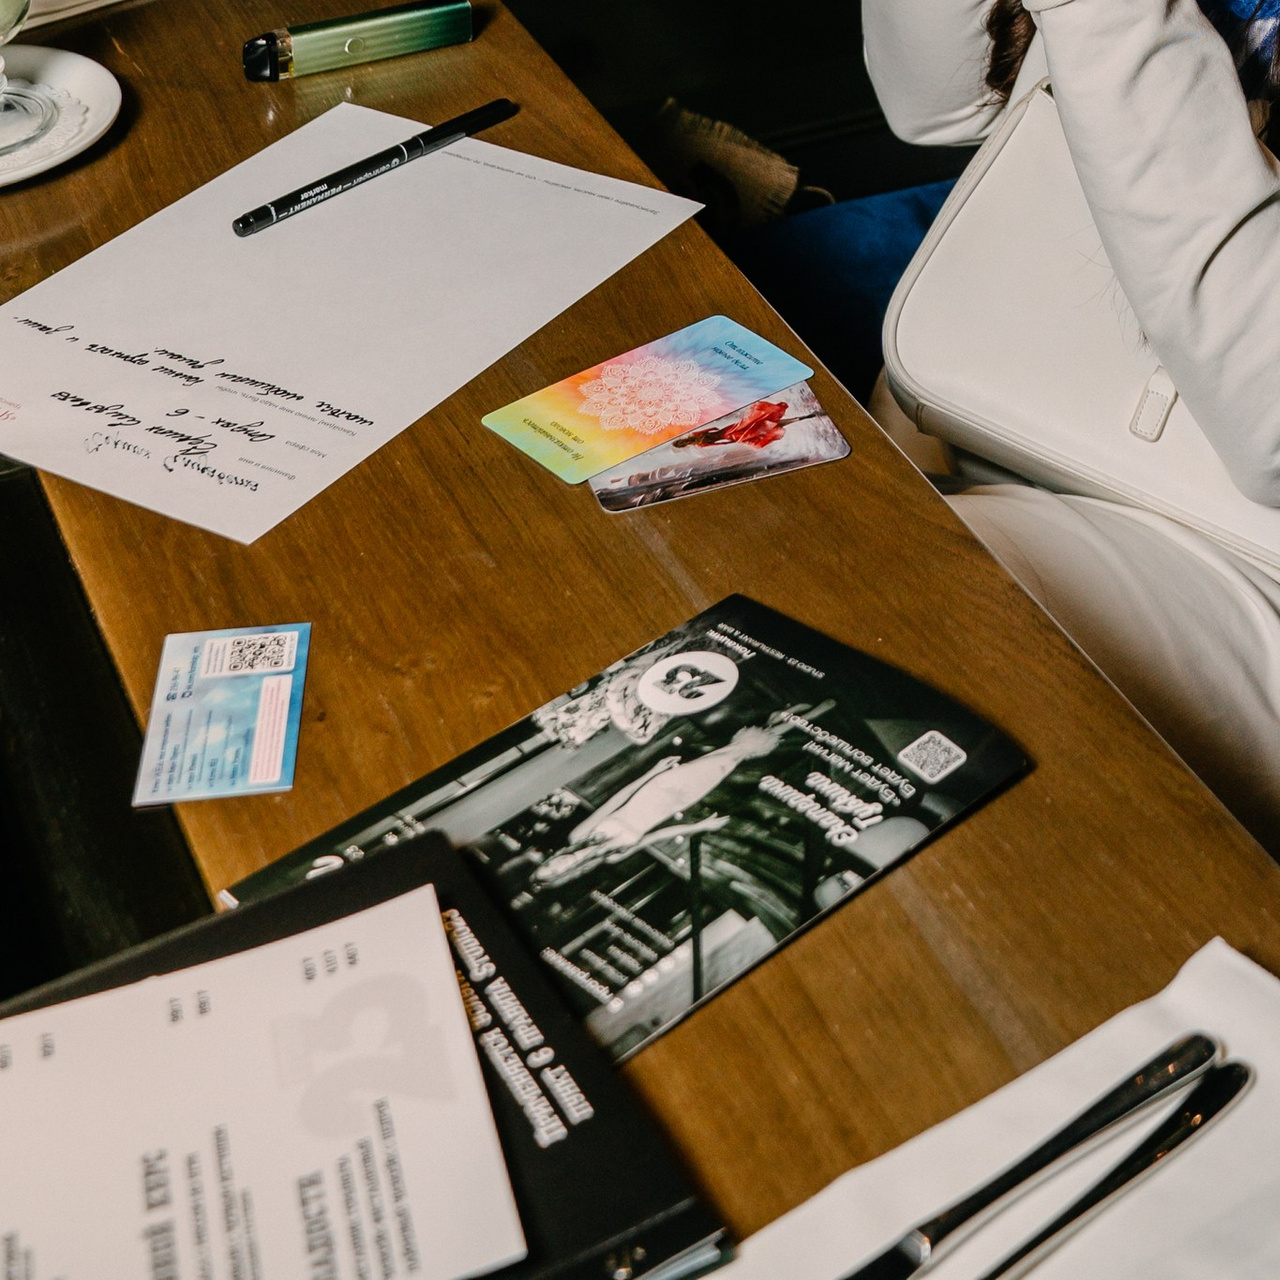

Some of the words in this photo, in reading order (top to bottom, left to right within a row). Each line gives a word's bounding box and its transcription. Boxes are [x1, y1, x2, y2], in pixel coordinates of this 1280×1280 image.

[353, 162, 391, 186] centropen
[289, 184, 342, 216] PERMANENT
[300, 183, 328, 201] marker
[285, 440, 308, 453] сфера
[308, 448, 327, 459] Моя
[260, 463, 297, 481] Фамилия
[706, 628, 757, 659] Локация:
[738, 631, 785, 660] RESTAURANT
[652, 663, 727, 699] 23
[800, 660, 825, 679] STUDIO
[780, 710, 874, 766] волшебство!»
[802, 740, 854, 773] магия!
[851, 767, 901, 807] «Будет
[871, 761, 916, 800] Будет
[758, 775, 859, 847] Екатерина
